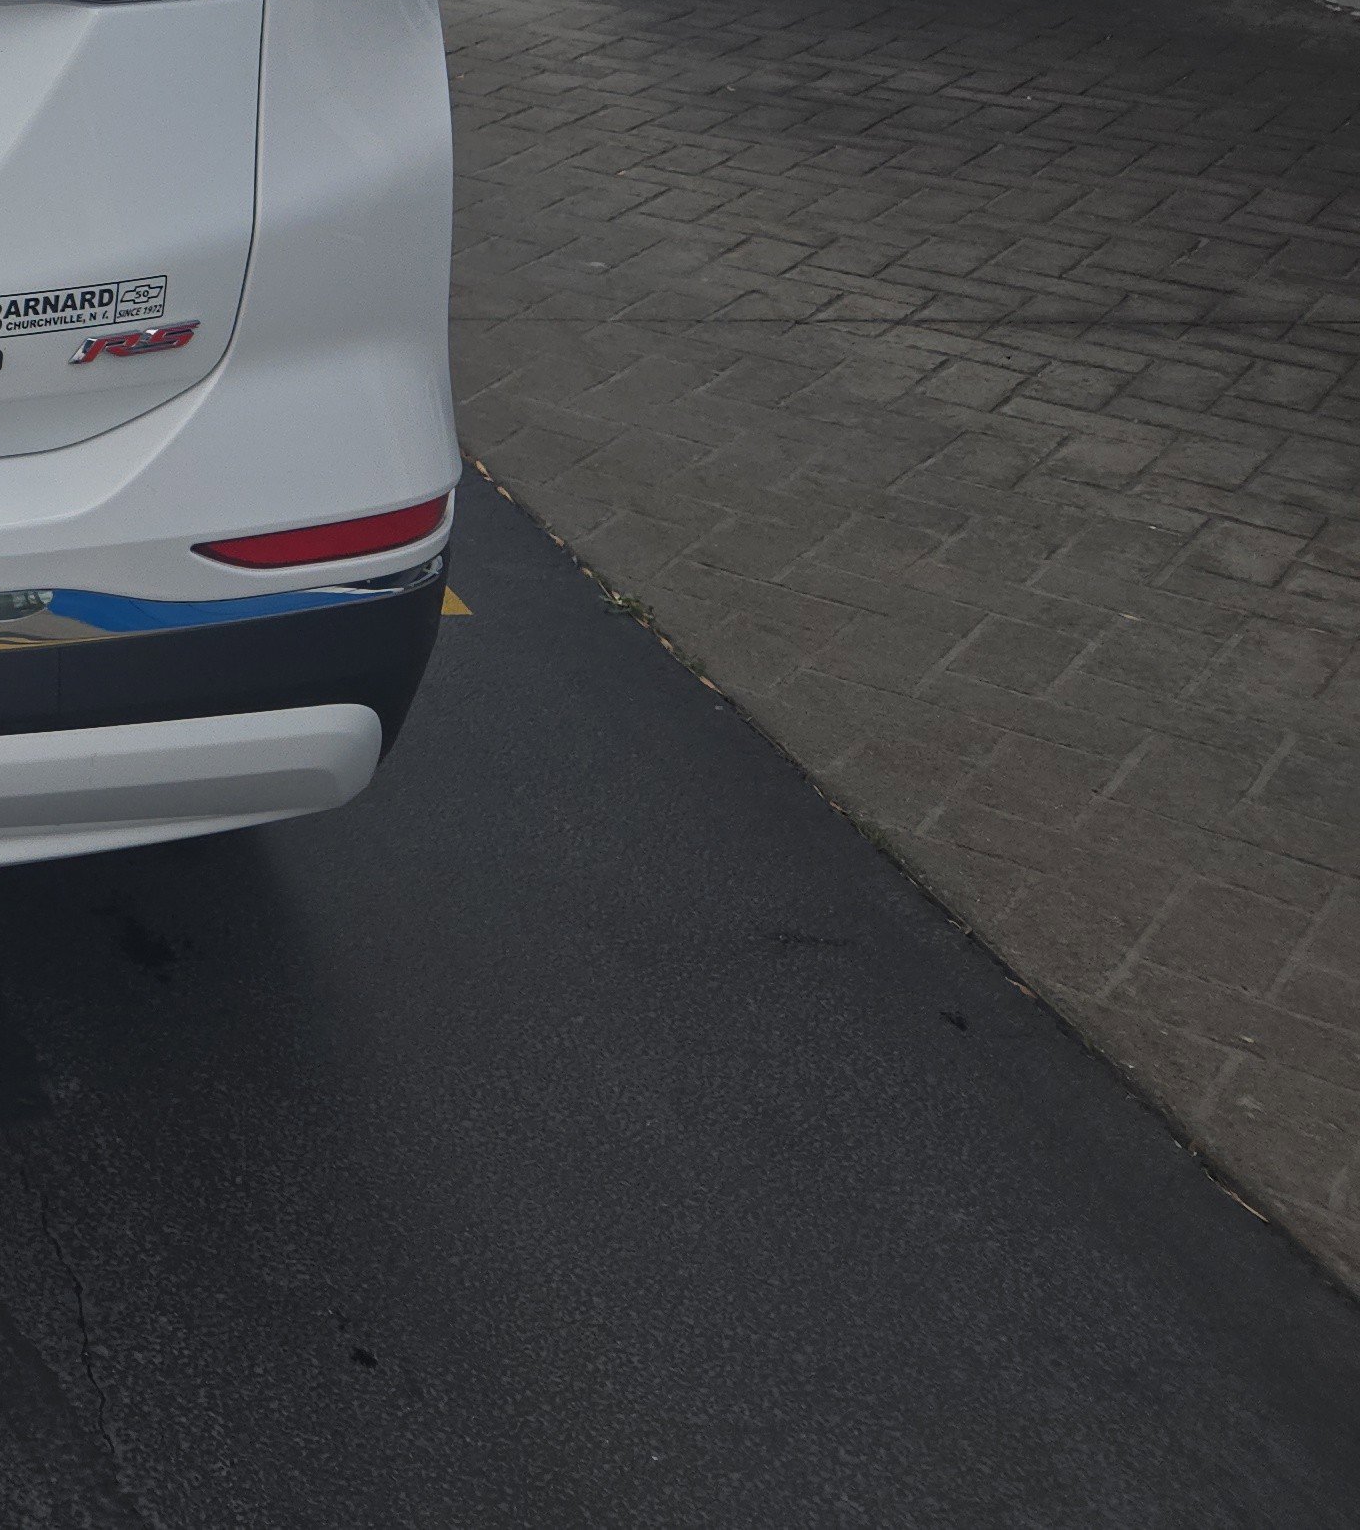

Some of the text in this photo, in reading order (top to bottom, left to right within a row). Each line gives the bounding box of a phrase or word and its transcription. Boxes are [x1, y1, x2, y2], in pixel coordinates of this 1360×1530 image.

[134, 289, 150, 299] 50
[116, 304, 162, 319] SINCE 1972
[5, 313, 86, 331] CHURCHVILLE,
[68, 321, 201, 364] RS
